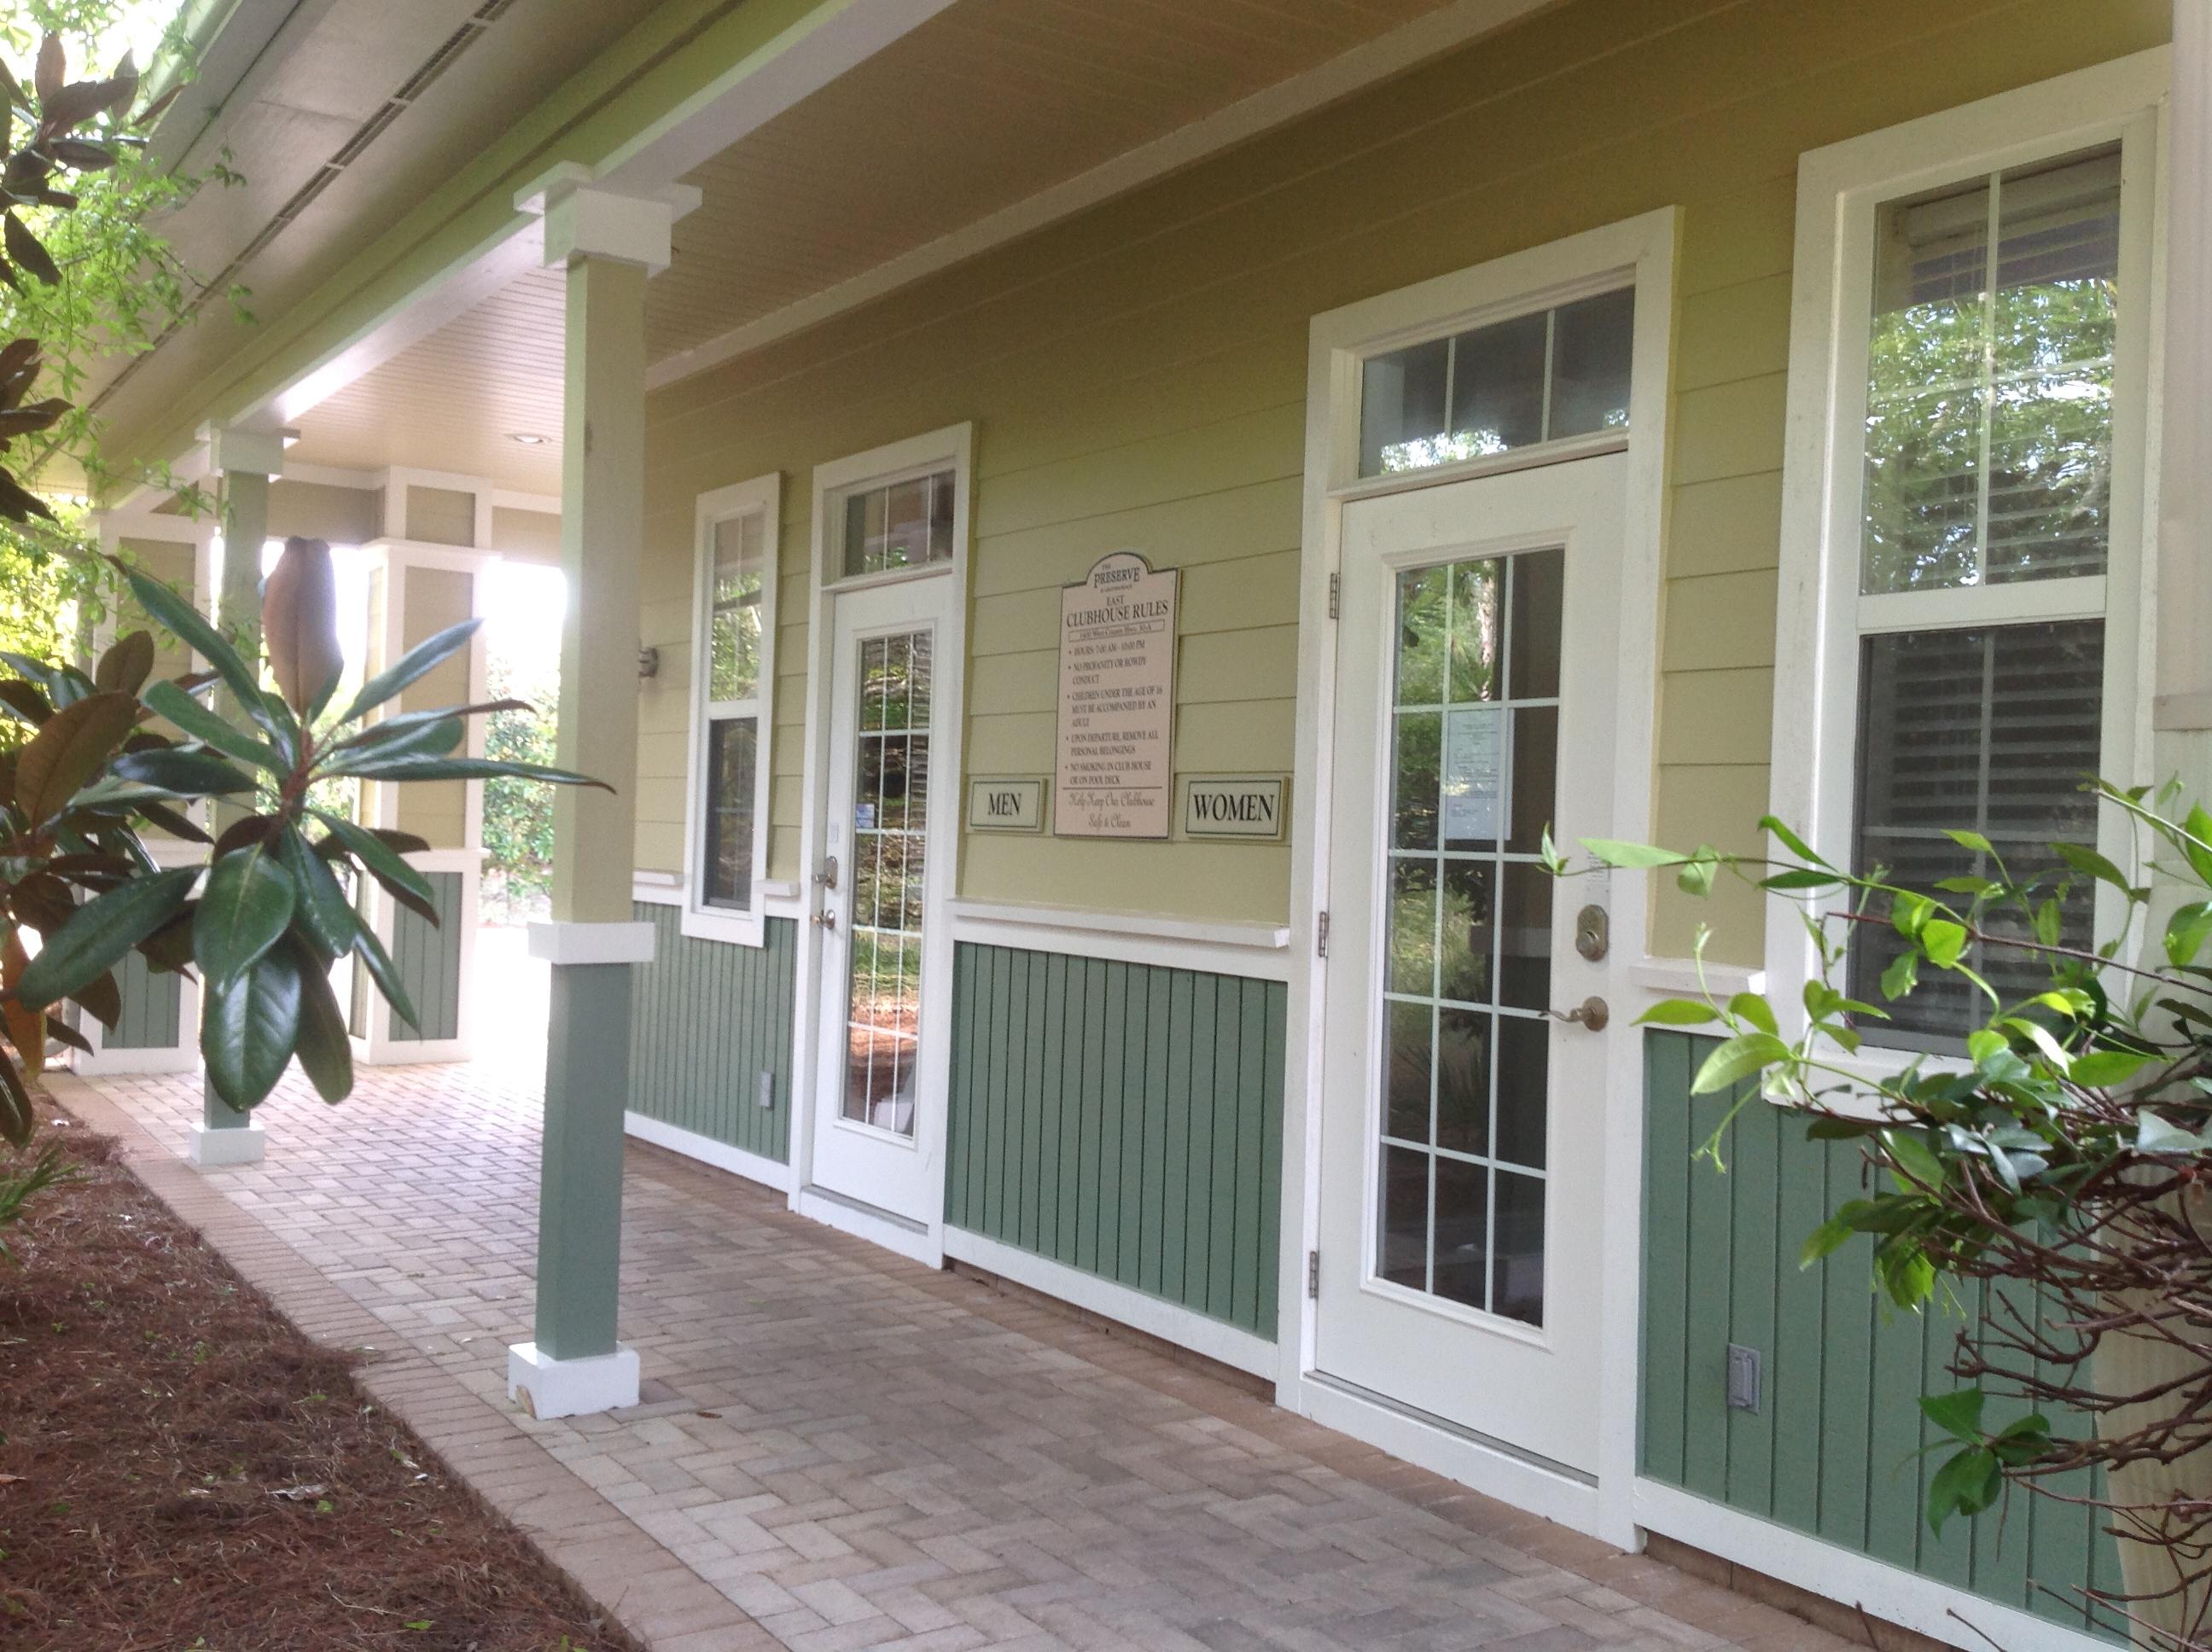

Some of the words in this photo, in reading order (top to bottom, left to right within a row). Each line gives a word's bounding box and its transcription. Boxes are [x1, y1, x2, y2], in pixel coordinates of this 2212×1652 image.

[1094, 567, 1140, 588] PRESERVE
[1106, 595, 1125, 606] EAST
[1067, 605, 1130, 627] CLUBHOUSE
[1132, 600, 1168, 619] RULES
[1108, 643, 1116, 653] AM
[1136, 640, 1145, 649] PM
[1074, 661, 1083, 671] NO
[1083, 659, 1113, 671] PROFANITY
[1115, 658, 1123, 669] OR
[1124, 656, 1146, 667] ROWDY
[1073, 674, 1099, 685] CONDUCT
[1072, 690, 1099, 701] CHILDREN
[1101, 689, 1121, 699] UNDER
[1121, 687, 1132, 697] THE
[1135, 686, 1145, 696] AGE
[1147, 685, 1155, 695] OF
[1072, 704, 1086, 714] MUST
[1088, 703, 1095, 713] BE
[1097, 701, 1137, 713] ACCOMPANIED
[1138, 700, 1146, 710] BY
[1147, 700, 1156, 710] AN
[1072, 718, 1089, 727] ADULT
[1072, 734, 1087, 743] UPON
[1122, 730, 1146, 741] REMOVE
[1147, 730, 1159, 741] ALL
[1071, 746, 1097, 757] PERSONAL
[1098, 745, 1137, 755] BELONGINGS
[1070, 762, 1080, 771] NO
[1080, 762, 1106, 771] SMOKING
[1107, 762, 1114, 771] IN
[1115, 761, 1131, 771] CLUB
[1131, 760, 1151, 771] HOUSE
[1070, 776, 1079, 785] OR
[1079, 775, 1088, 785] ON
[1088, 775, 1103, 785] POOL
[1104, 775, 1121, 785] DECK
[987, 792, 1022, 816] MEN
[1121, 791, 1154, 806] Clubhouse
[1193, 794, 1275, 821] WOMEN
[1088, 812, 1103, 831] Safe
[1110, 812, 1131, 828] Clean
